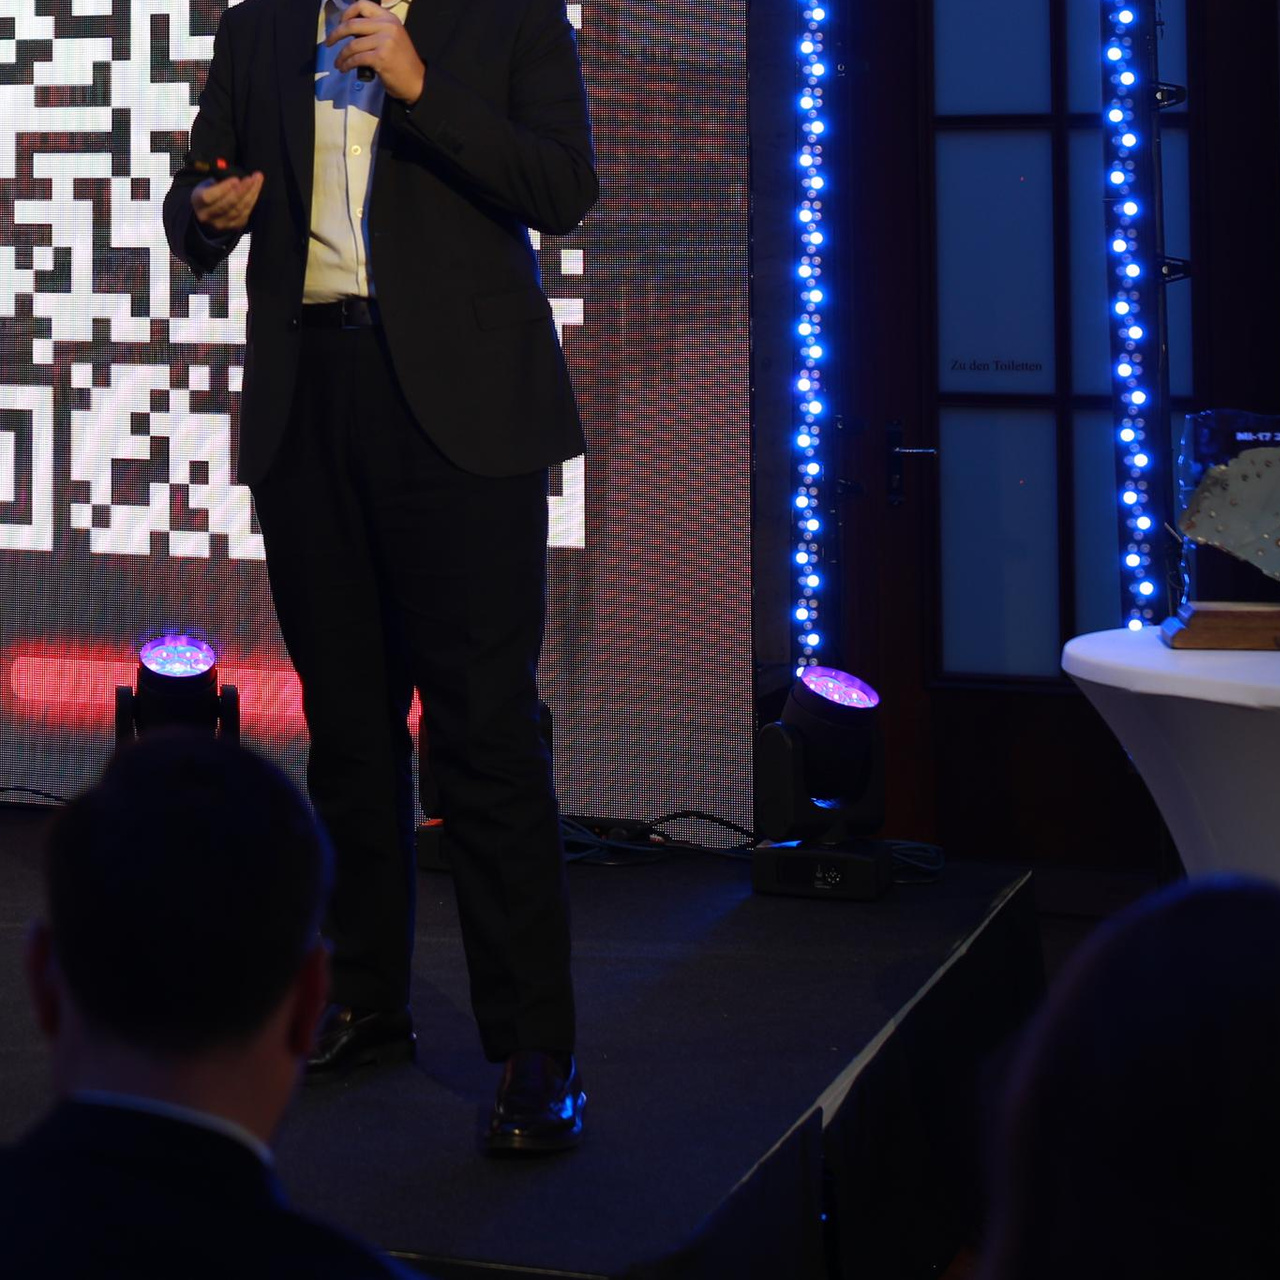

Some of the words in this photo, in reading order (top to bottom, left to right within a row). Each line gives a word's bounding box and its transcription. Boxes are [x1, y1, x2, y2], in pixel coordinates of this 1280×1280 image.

[950, 360, 966, 371] Zu
[969, 360, 990, 371] den
[993, 360, 1042, 371] Toiletten
